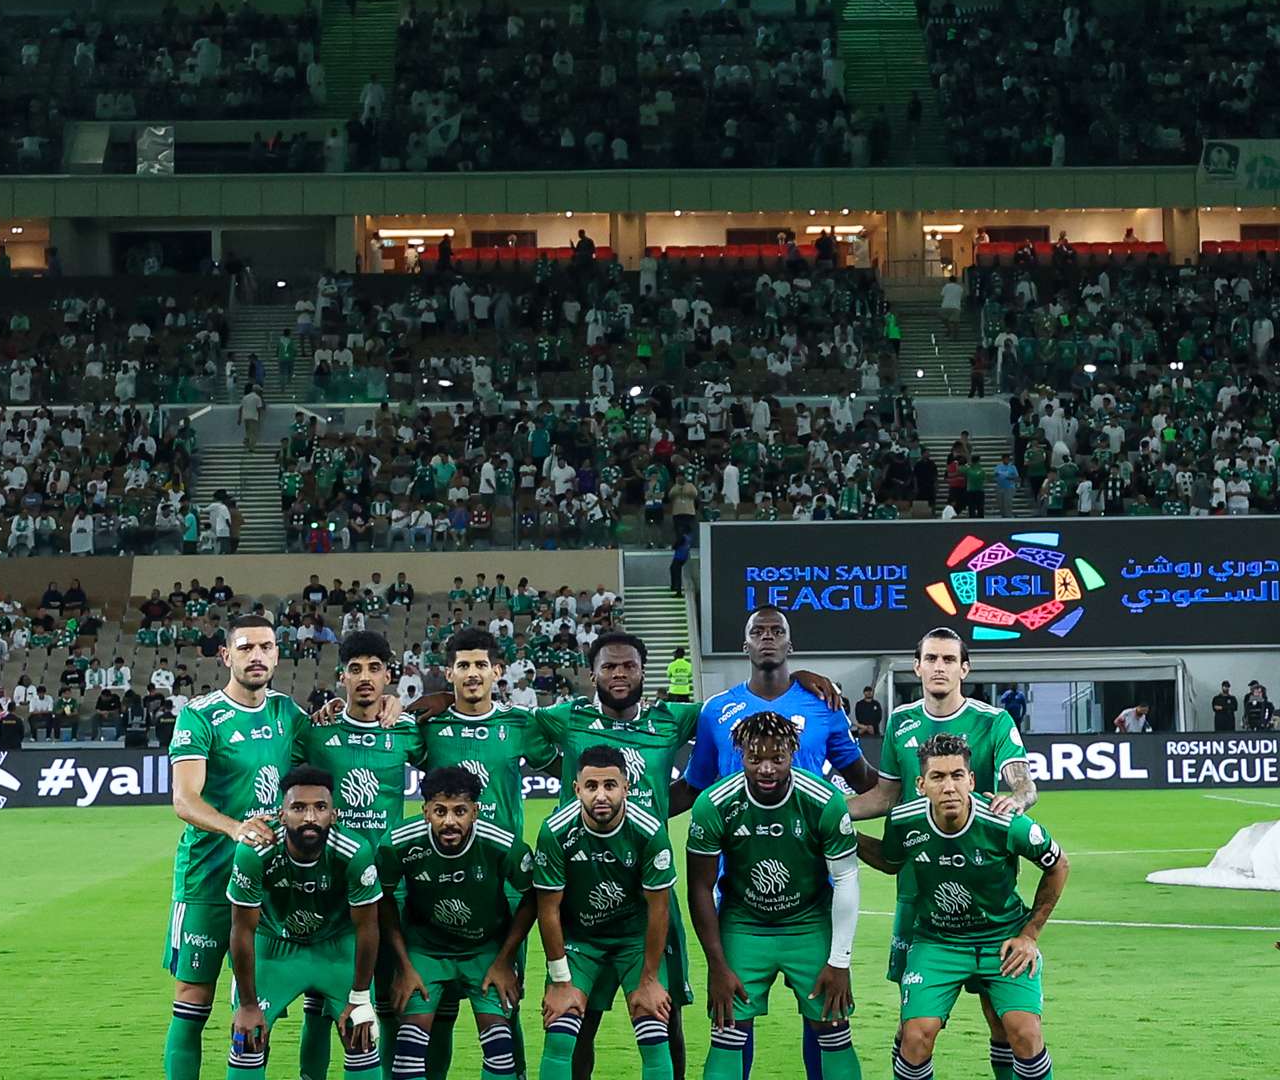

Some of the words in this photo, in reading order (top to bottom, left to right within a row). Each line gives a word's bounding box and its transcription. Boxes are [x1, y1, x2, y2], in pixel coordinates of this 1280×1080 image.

[746, 566, 829, 581] ROSHN
[835, 565, 908, 581] SAUDI
[1120, 555, 1202, 579] روشن
[1208, 560, 1279, 582] دوري
[746, 584, 908, 610] LEAGUE
[985, 574, 1050, 596] RSL
[1120, 580, 1280, 613] السعودي
[1166, 741, 1224, 756] ROSHN
[1228, 739, 1278, 755] SAUDI
[37, 755, 169, 807] #yall
[1167, 758, 1279, 784] LEAGUE
